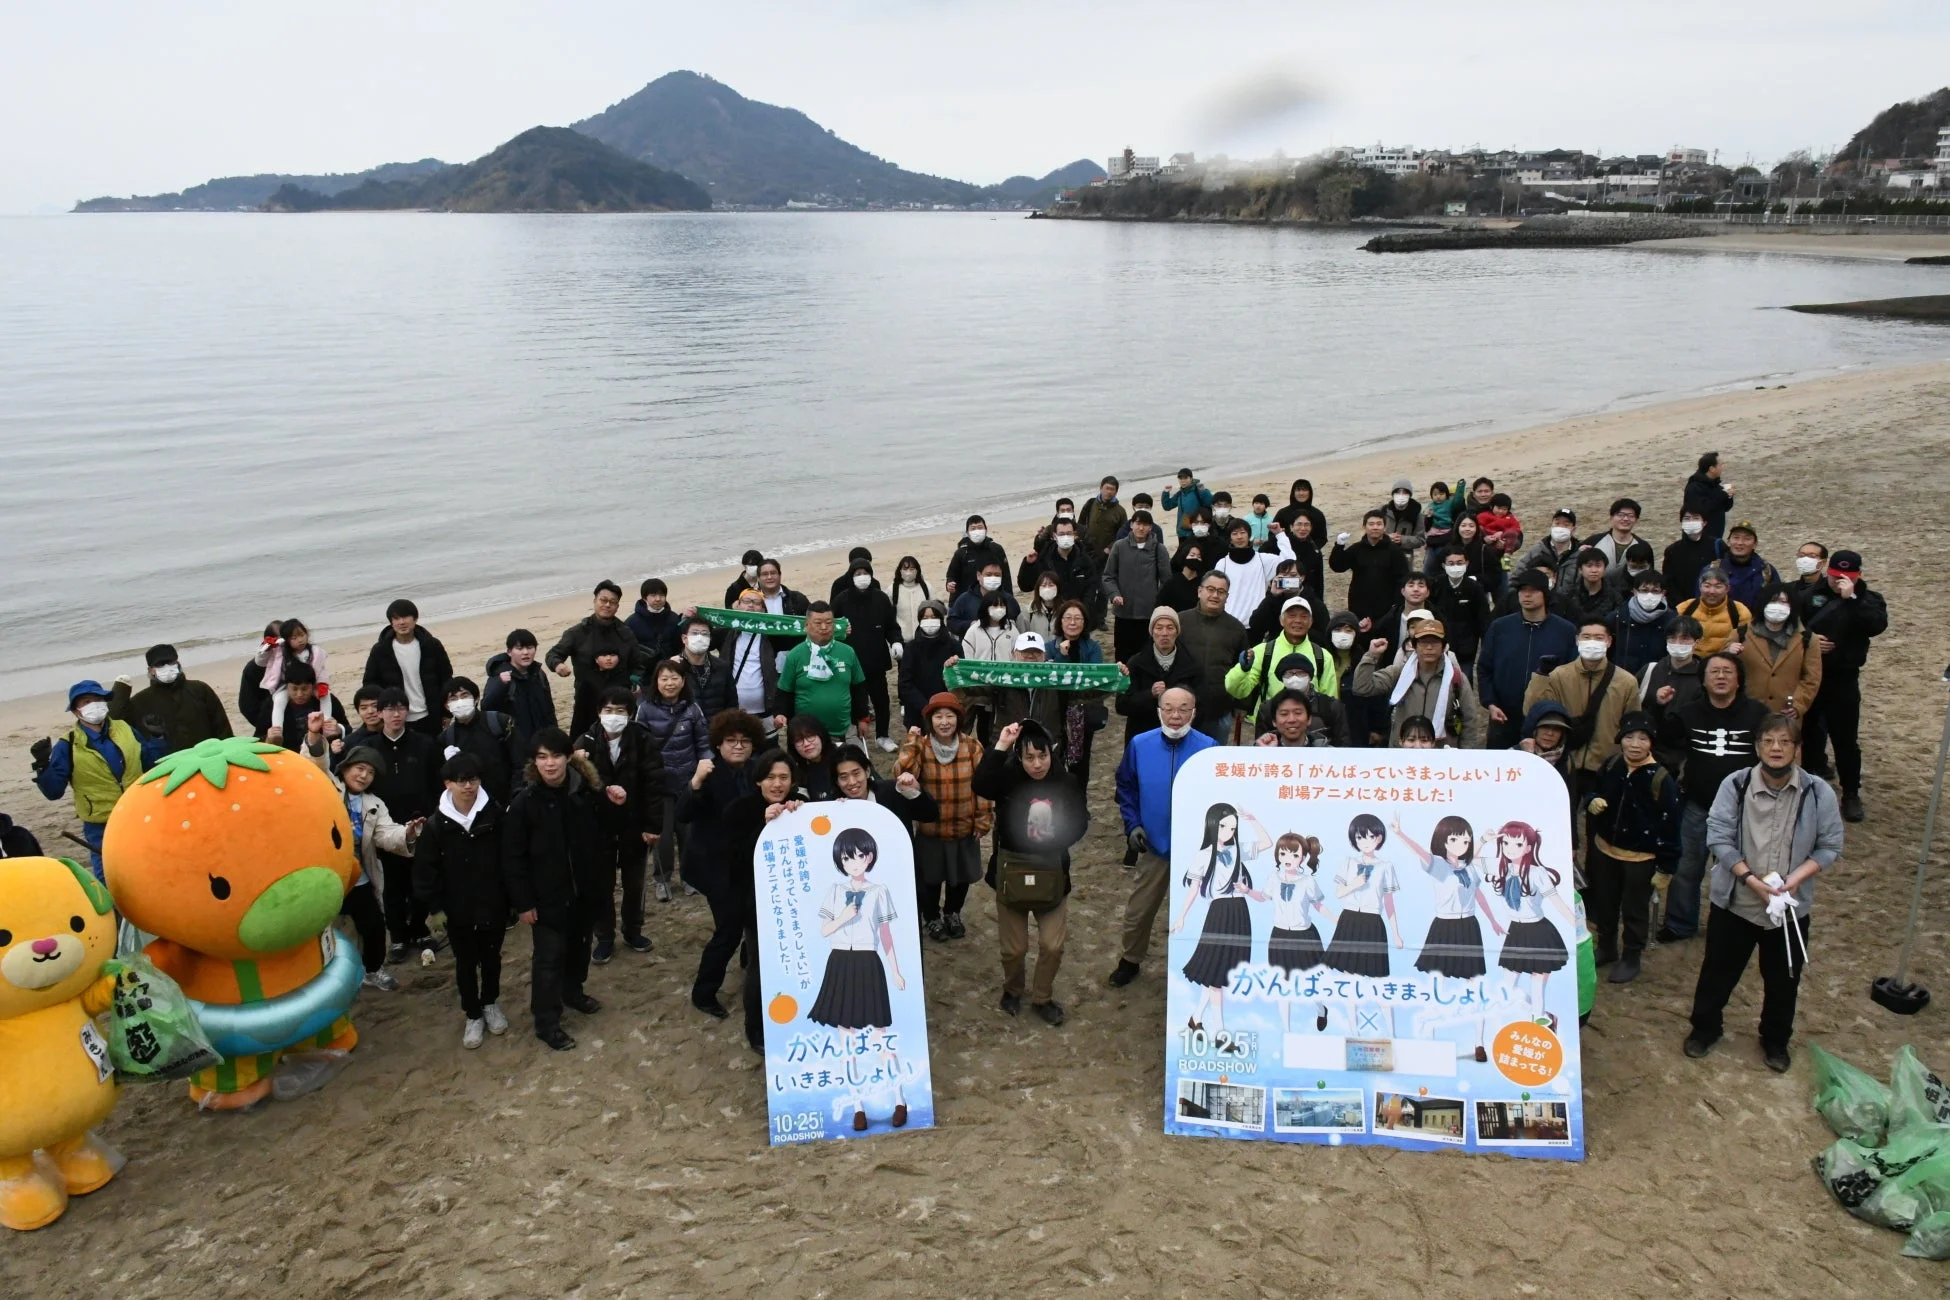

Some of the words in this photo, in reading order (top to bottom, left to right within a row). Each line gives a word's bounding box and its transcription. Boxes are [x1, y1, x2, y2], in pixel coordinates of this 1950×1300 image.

[1278, 785, 1453, 802] 劇場アニメになりました！
[794, 834, 811, 893] 愛媛が誇る
[763, 839, 791, 975] 劇場アニメになりました！
[778, 838, 811, 990] 「がんばっていきまっしょい」が
[1231, 967, 1509, 1007] がんばっていきまっしょい
[788, 1027, 898, 1063] がんばって
[1509, 1030, 1553, 1051] みんなの
[1512, 1044, 1546, 1061] 愛媛が
[775, 1060, 914, 1092] いきまっしょい
[1178, 1059, 1257, 1074] ROADSHOW
[1498, 1052, 1553, 1077] 詰まってる！
[774, 1130, 825, 1143] ROADSHOW
